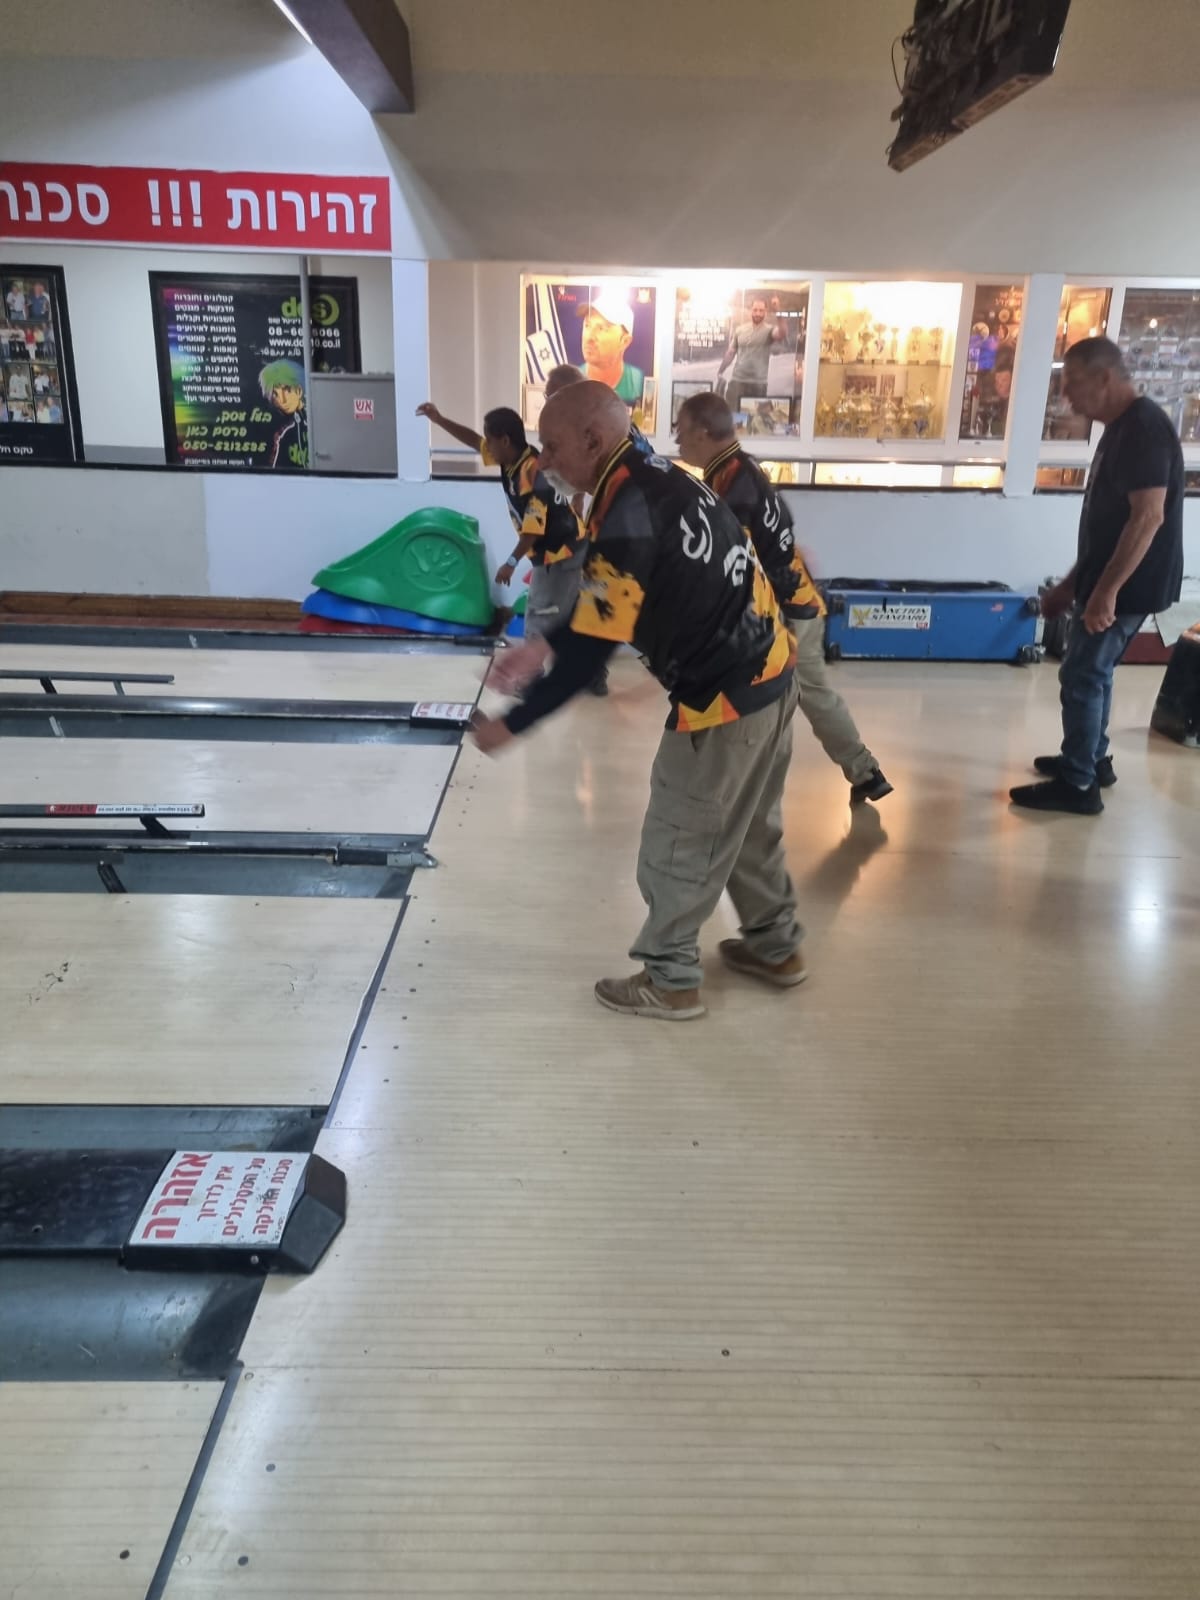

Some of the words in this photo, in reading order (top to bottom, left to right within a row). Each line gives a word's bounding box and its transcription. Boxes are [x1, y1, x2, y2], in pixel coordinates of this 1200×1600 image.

[147, 179, 203, 228] !!!
[226, 188, 377, 235] זהירות
[203, 294, 233, 304] קטלוגים
[268, 338, 341, 348] www.do10.co.il
[355, 399, 372, 412] אש
[186, 425, 208, 438] כאן
[214, 1165, 235, 1181] אין
[270, 1158, 293, 1184] סכנת
[141, 1153, 213, 1240] אזהרה
[196, 1183, 224, 1222] לדרוך
[222, 1172, 259, 1236] המסלולים
